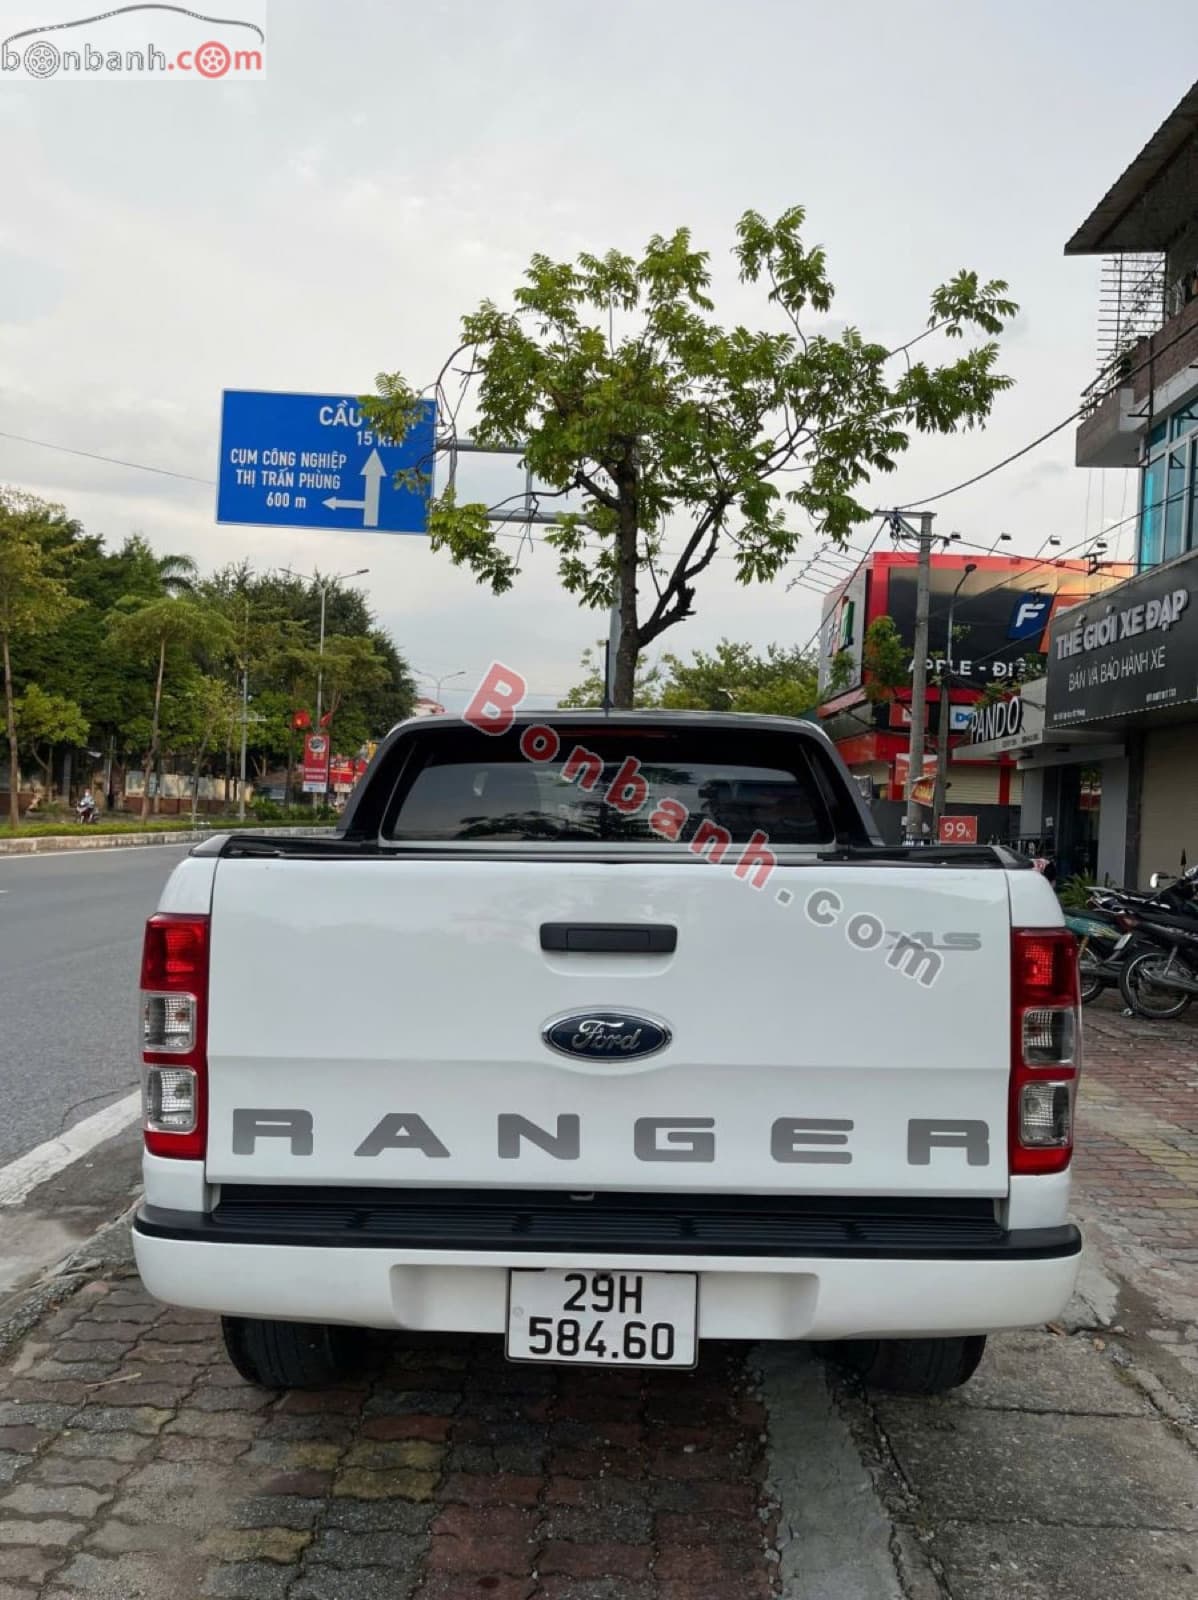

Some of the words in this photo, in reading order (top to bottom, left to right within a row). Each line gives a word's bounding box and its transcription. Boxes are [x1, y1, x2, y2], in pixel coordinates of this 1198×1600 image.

[357, 431, 373, 446] 15
[230, 448, 257, 467] CỤM
[262, 449, 296, 467] CÔNG
[301, 450, 347, 472] NGHIỆP
[236, 469, 256, 488] THỊ
[261, 466, 294, 487] TRẤN
[299, 471, 341, 490] PHÙNG
[266, 492, 290, 507] 600
[295, 496, 306, 508] m
[1056, 613, 1085, 660] THẾ
[1083, 605, 1118, 651] GIỚI
[1120, 604, 1145, 640] XE
[1145, 588, 1188, 632] ĐẠP
[1150, 645, 1166, 671] XE
[571, 1019, 643, 1050] Ford
[231, 1107, 990, 1167] RANGER
[563, 1273, 643, 1314] 29H
[528, 1316, 675, 1360] 584.60
